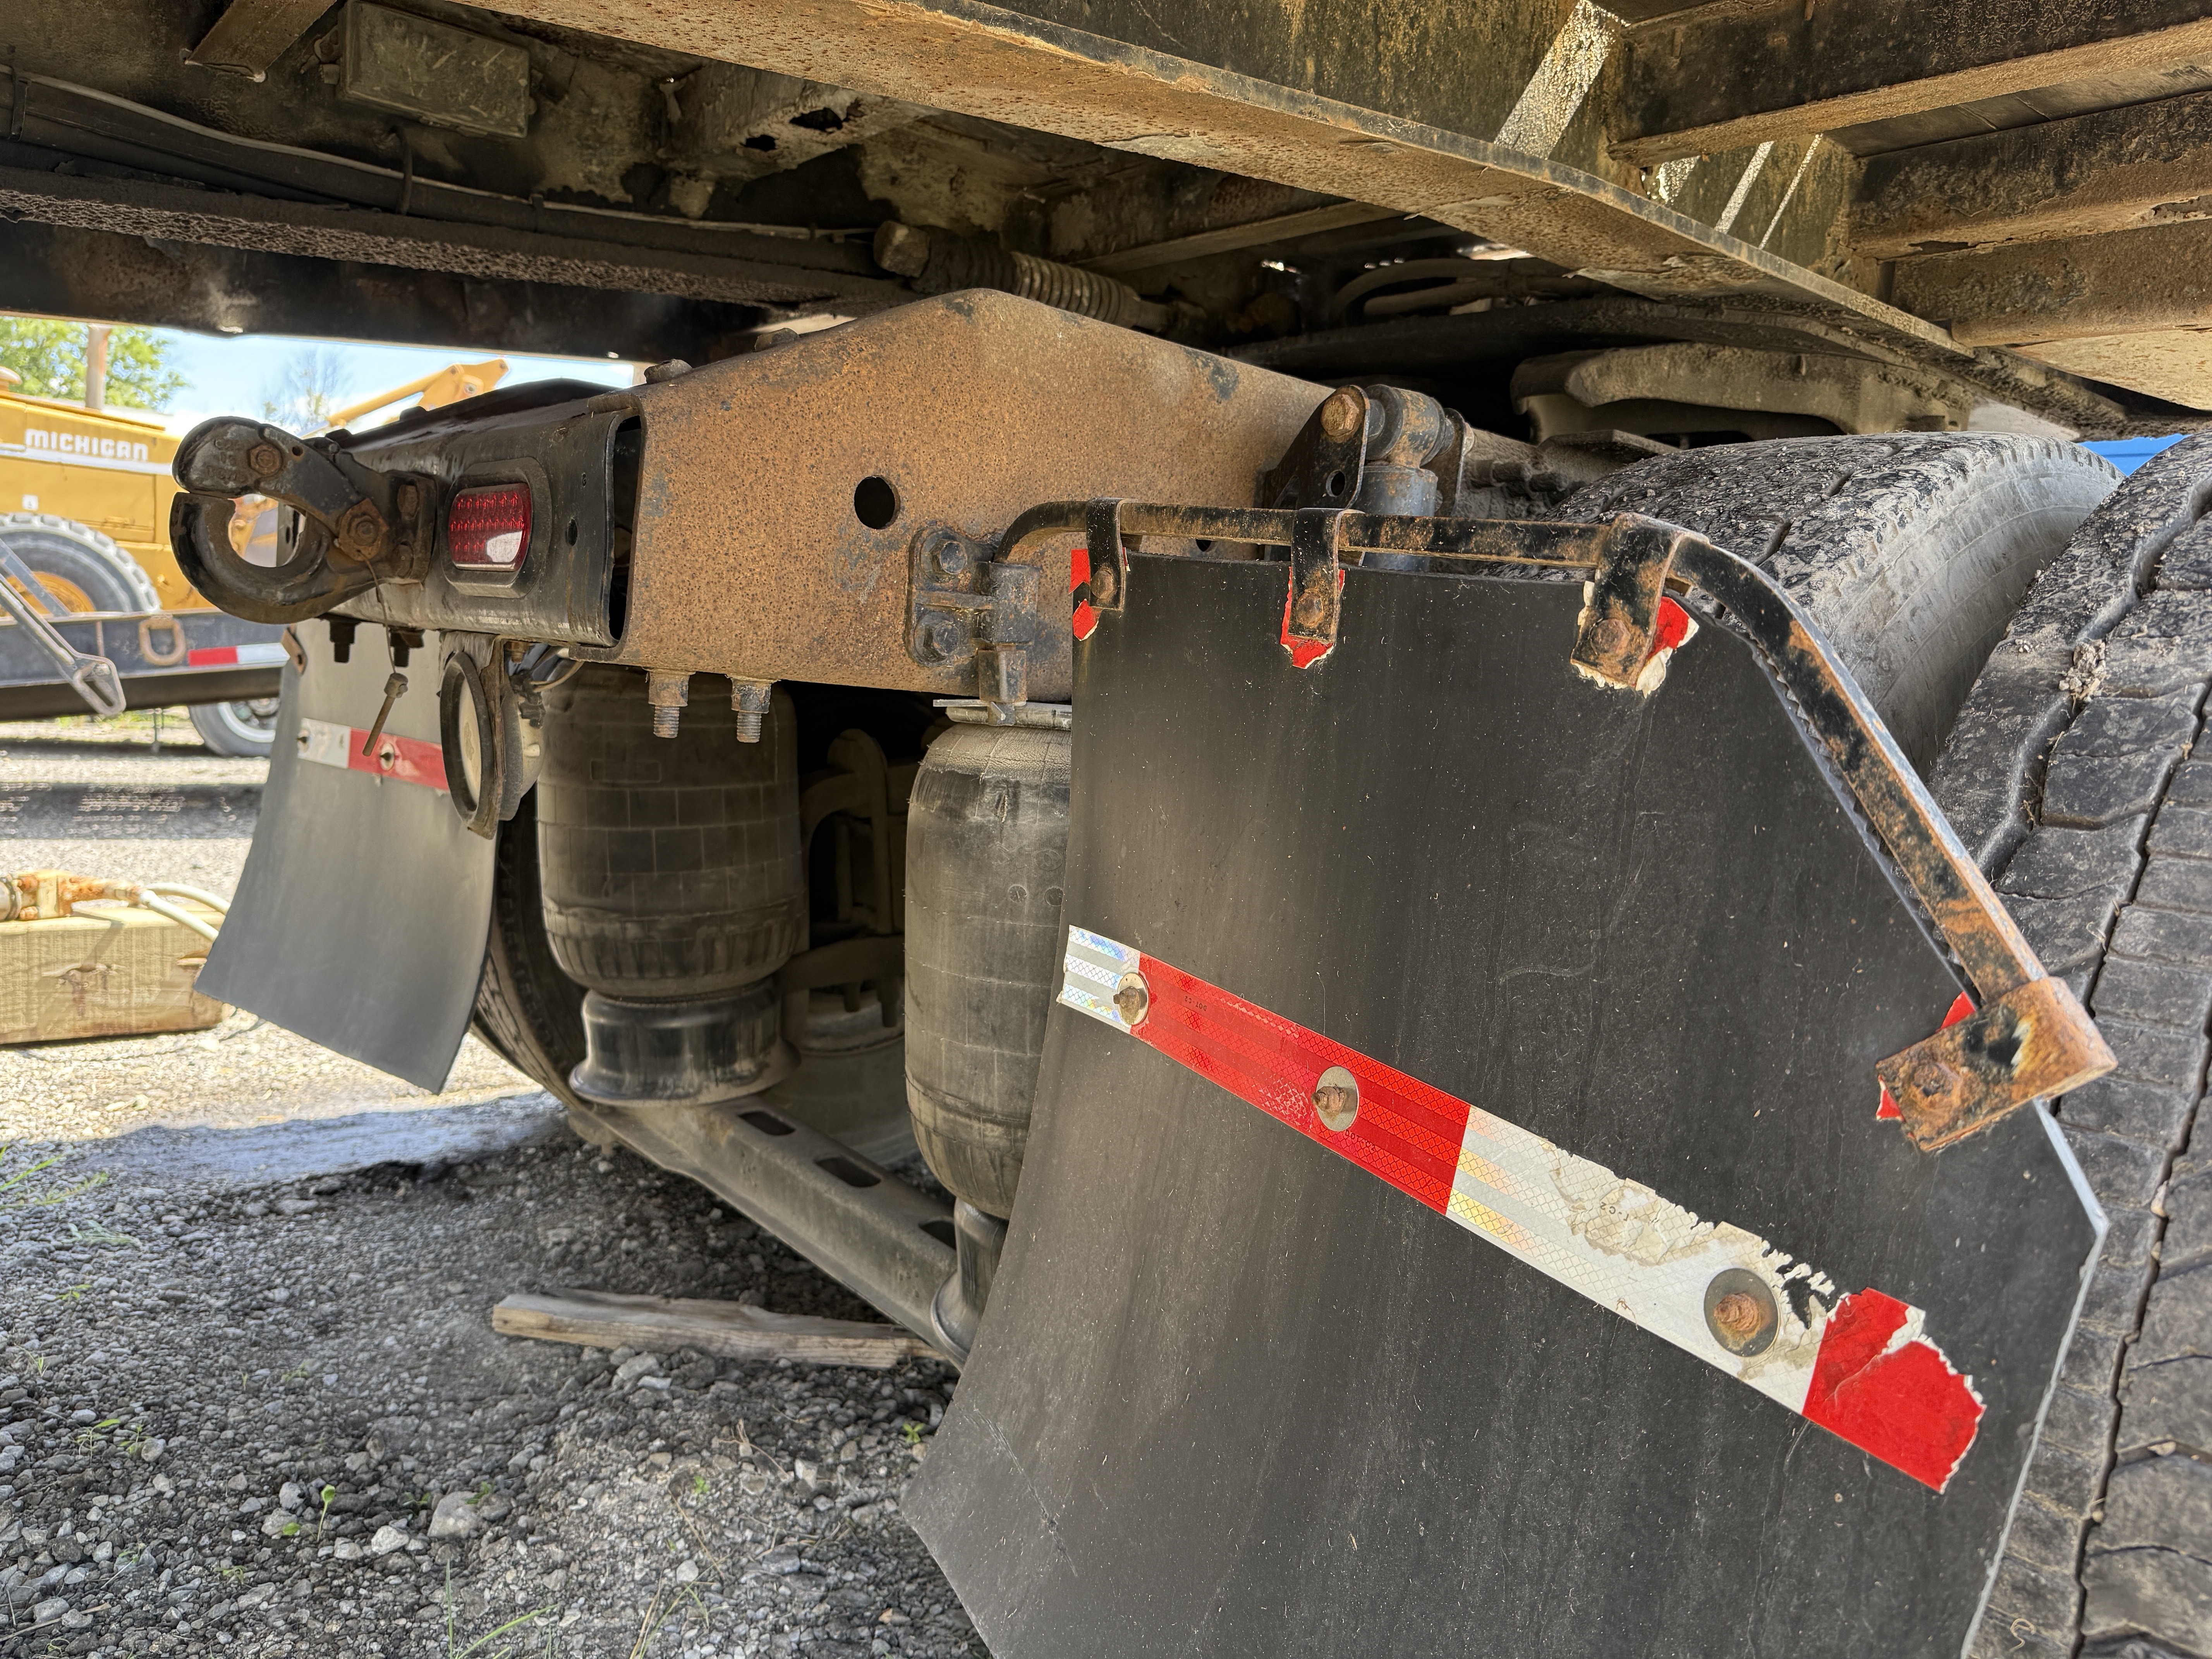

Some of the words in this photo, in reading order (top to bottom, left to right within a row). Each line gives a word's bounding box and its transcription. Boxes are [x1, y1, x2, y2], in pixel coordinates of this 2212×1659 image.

[25, 428, 148, 461] MICHIGAN
[1184, 996, 1207, 1012] DOT-C2
[1600, 1201, 1629, 1222] T-C2
